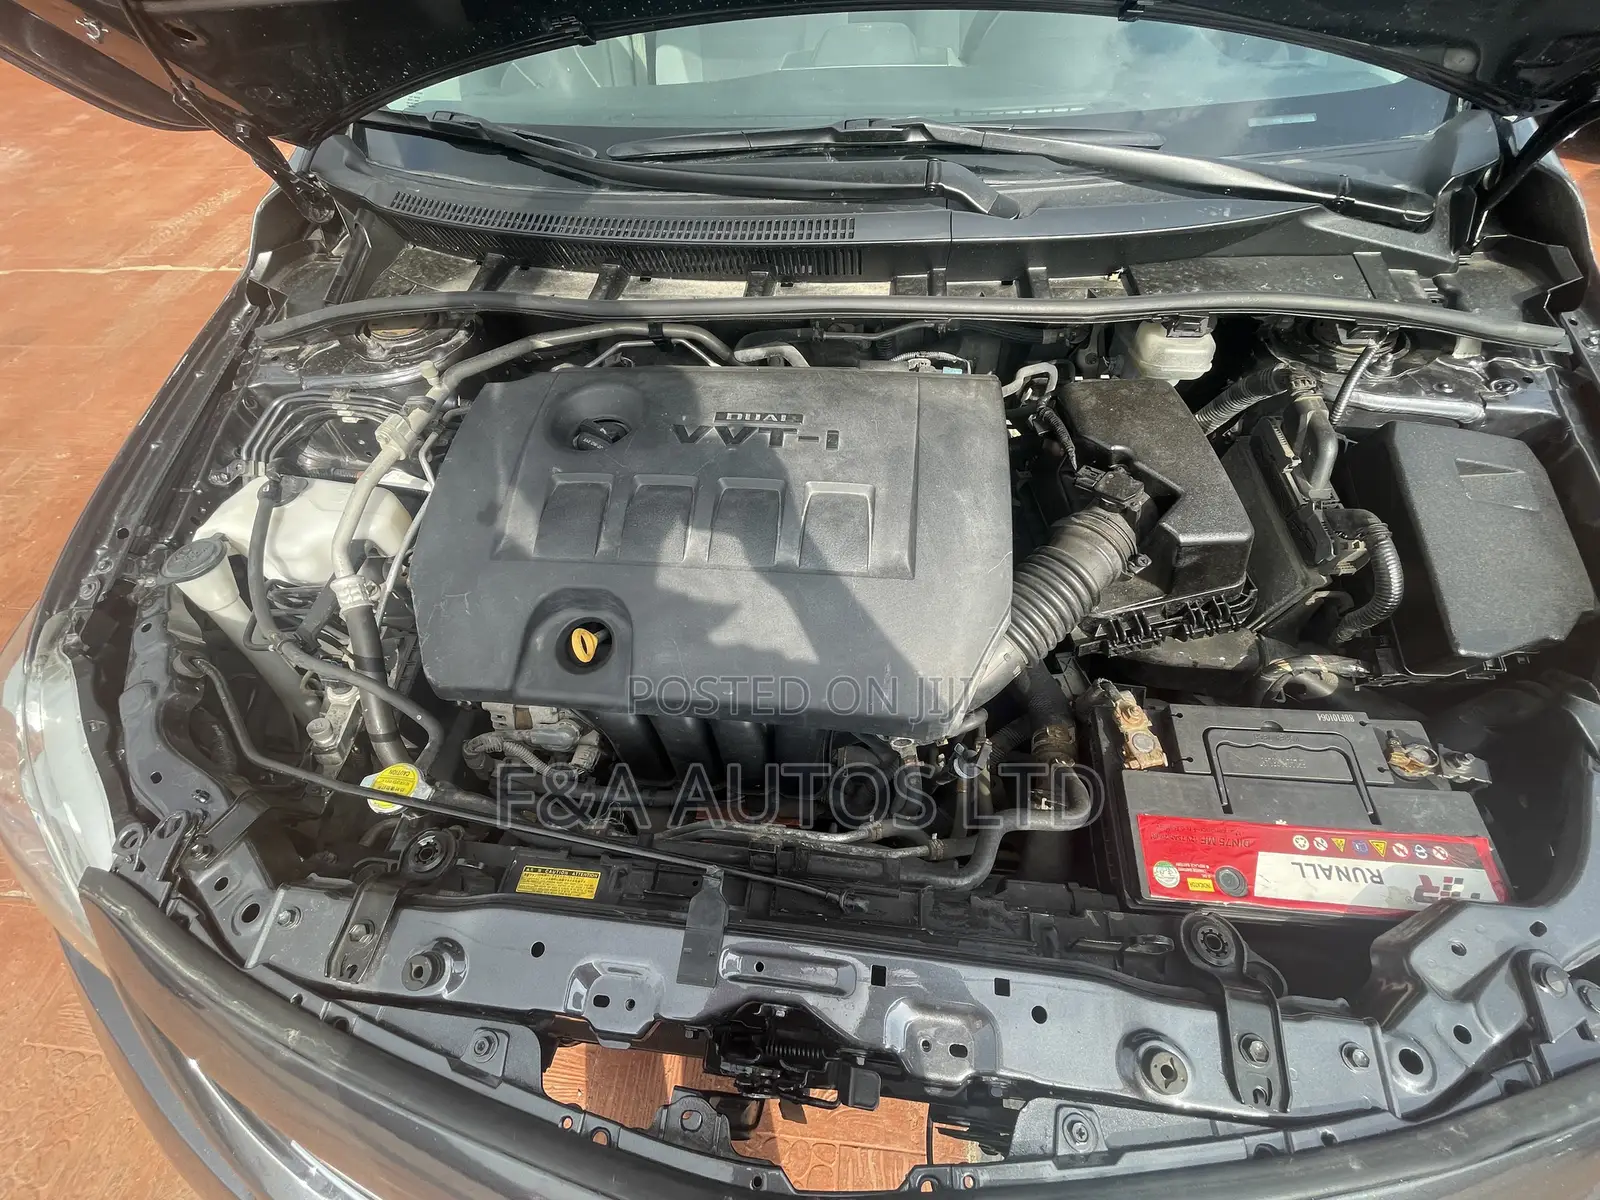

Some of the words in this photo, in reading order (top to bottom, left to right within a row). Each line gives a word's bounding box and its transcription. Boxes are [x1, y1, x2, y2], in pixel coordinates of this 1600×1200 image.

[726, 412, 790, 422] DUAL
[389, 769, 410, 777] CAUTION
[1291, 862, 1385, 885] RUNALL
